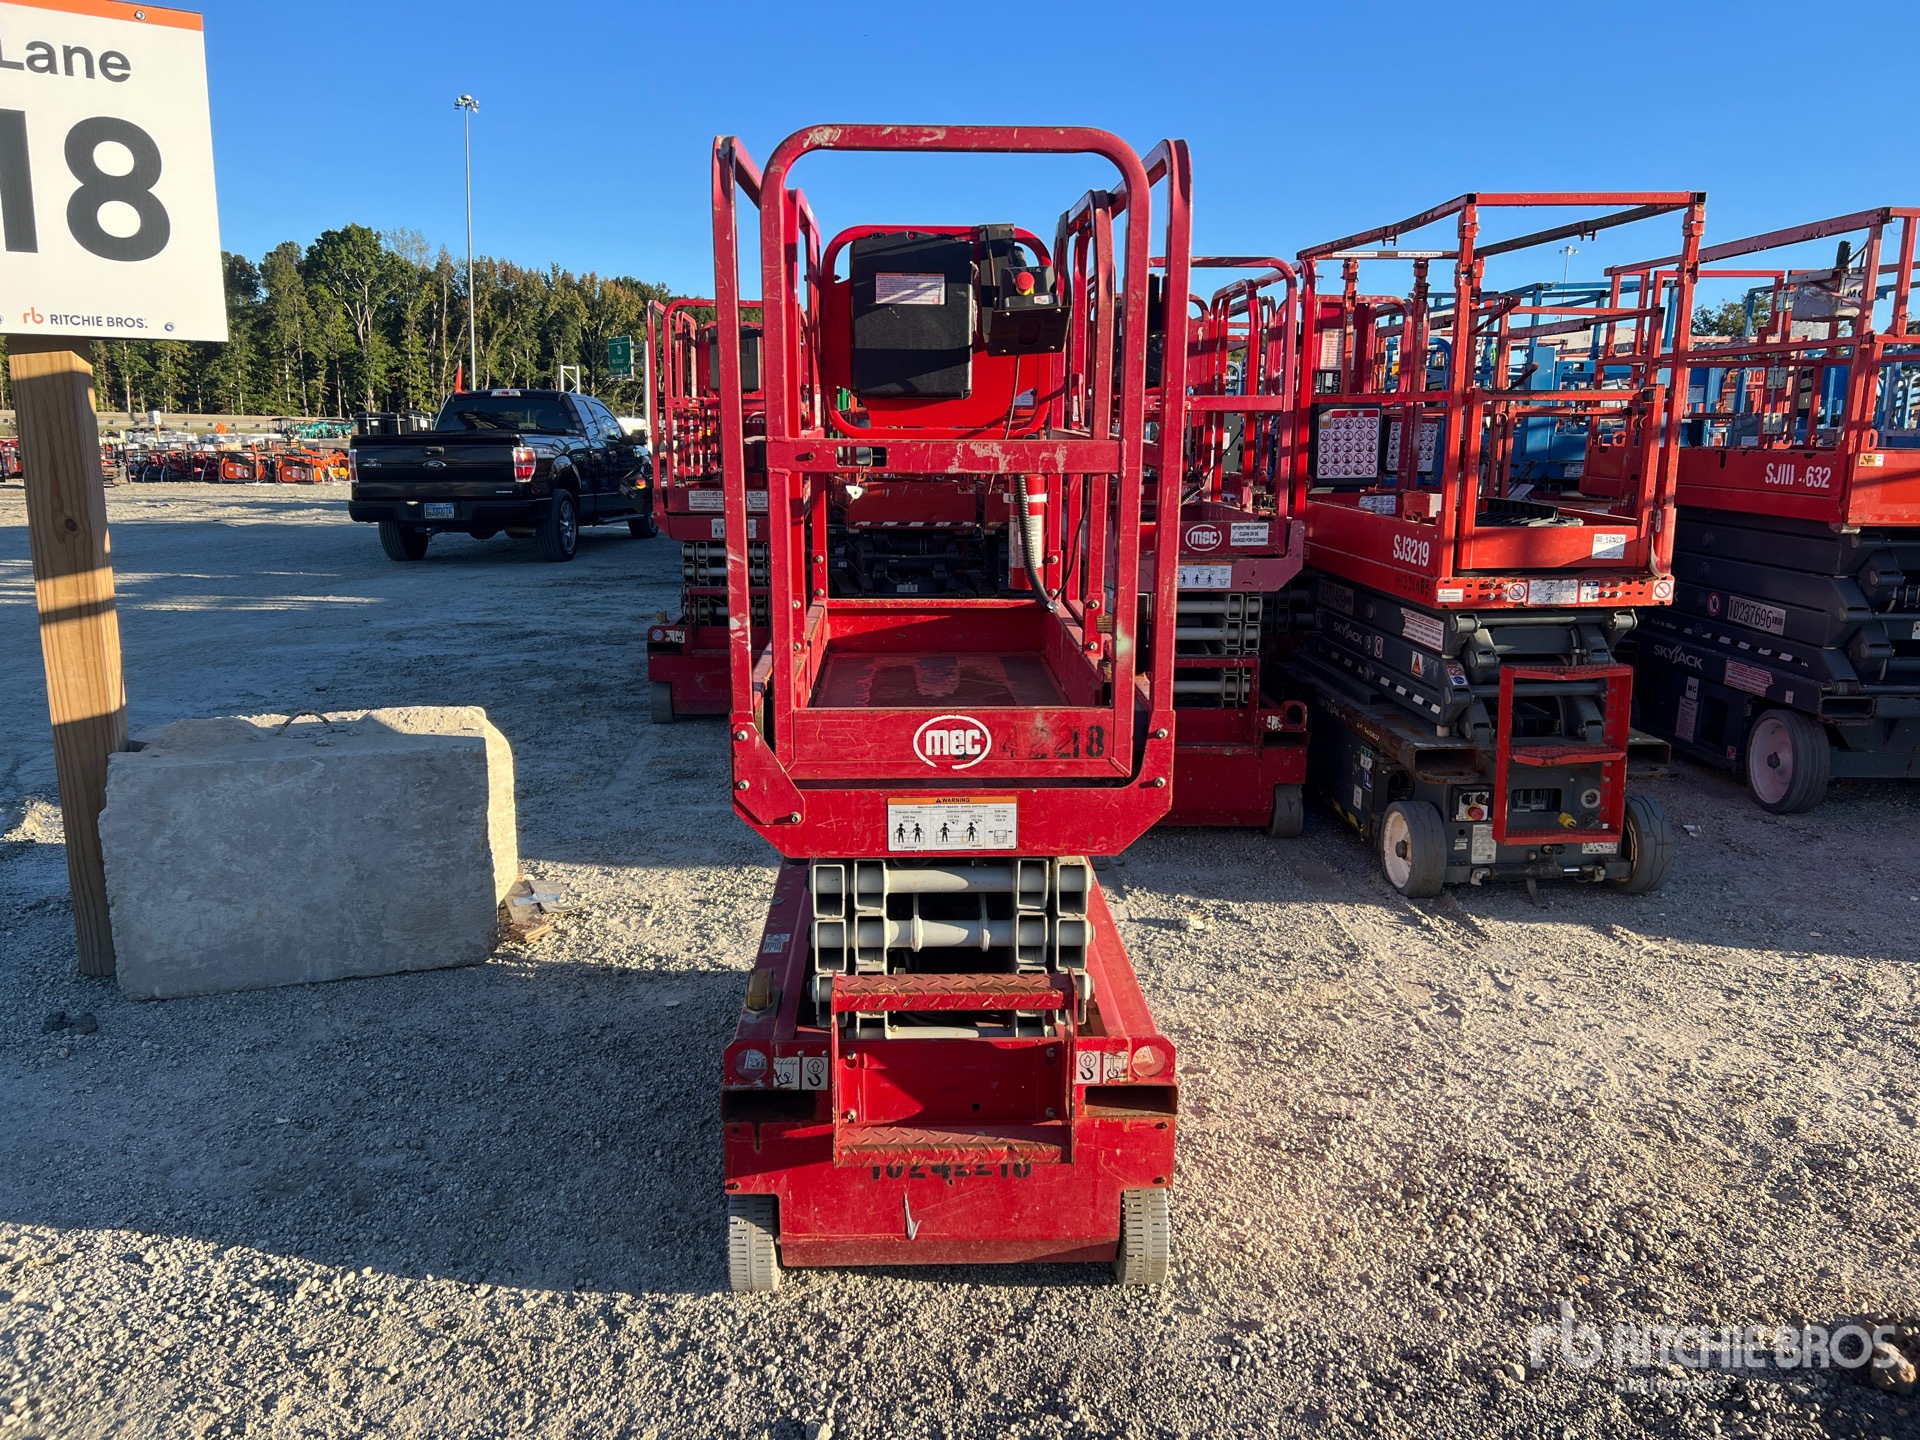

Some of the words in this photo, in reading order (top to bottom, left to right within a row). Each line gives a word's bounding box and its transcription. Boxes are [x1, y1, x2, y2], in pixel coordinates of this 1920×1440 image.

[0, 36, 132, 83] Lane
[0, 108, 171, 262] 18
[50, 314, 103, 327] RITCHIE
[1393, 534, 1430, 567] SJ3219
[1730, 599, 1772, 628] 10237696
[1654, 644, 1703, 670] SKYJACK
[1688, 684, 1697, 693] MC
